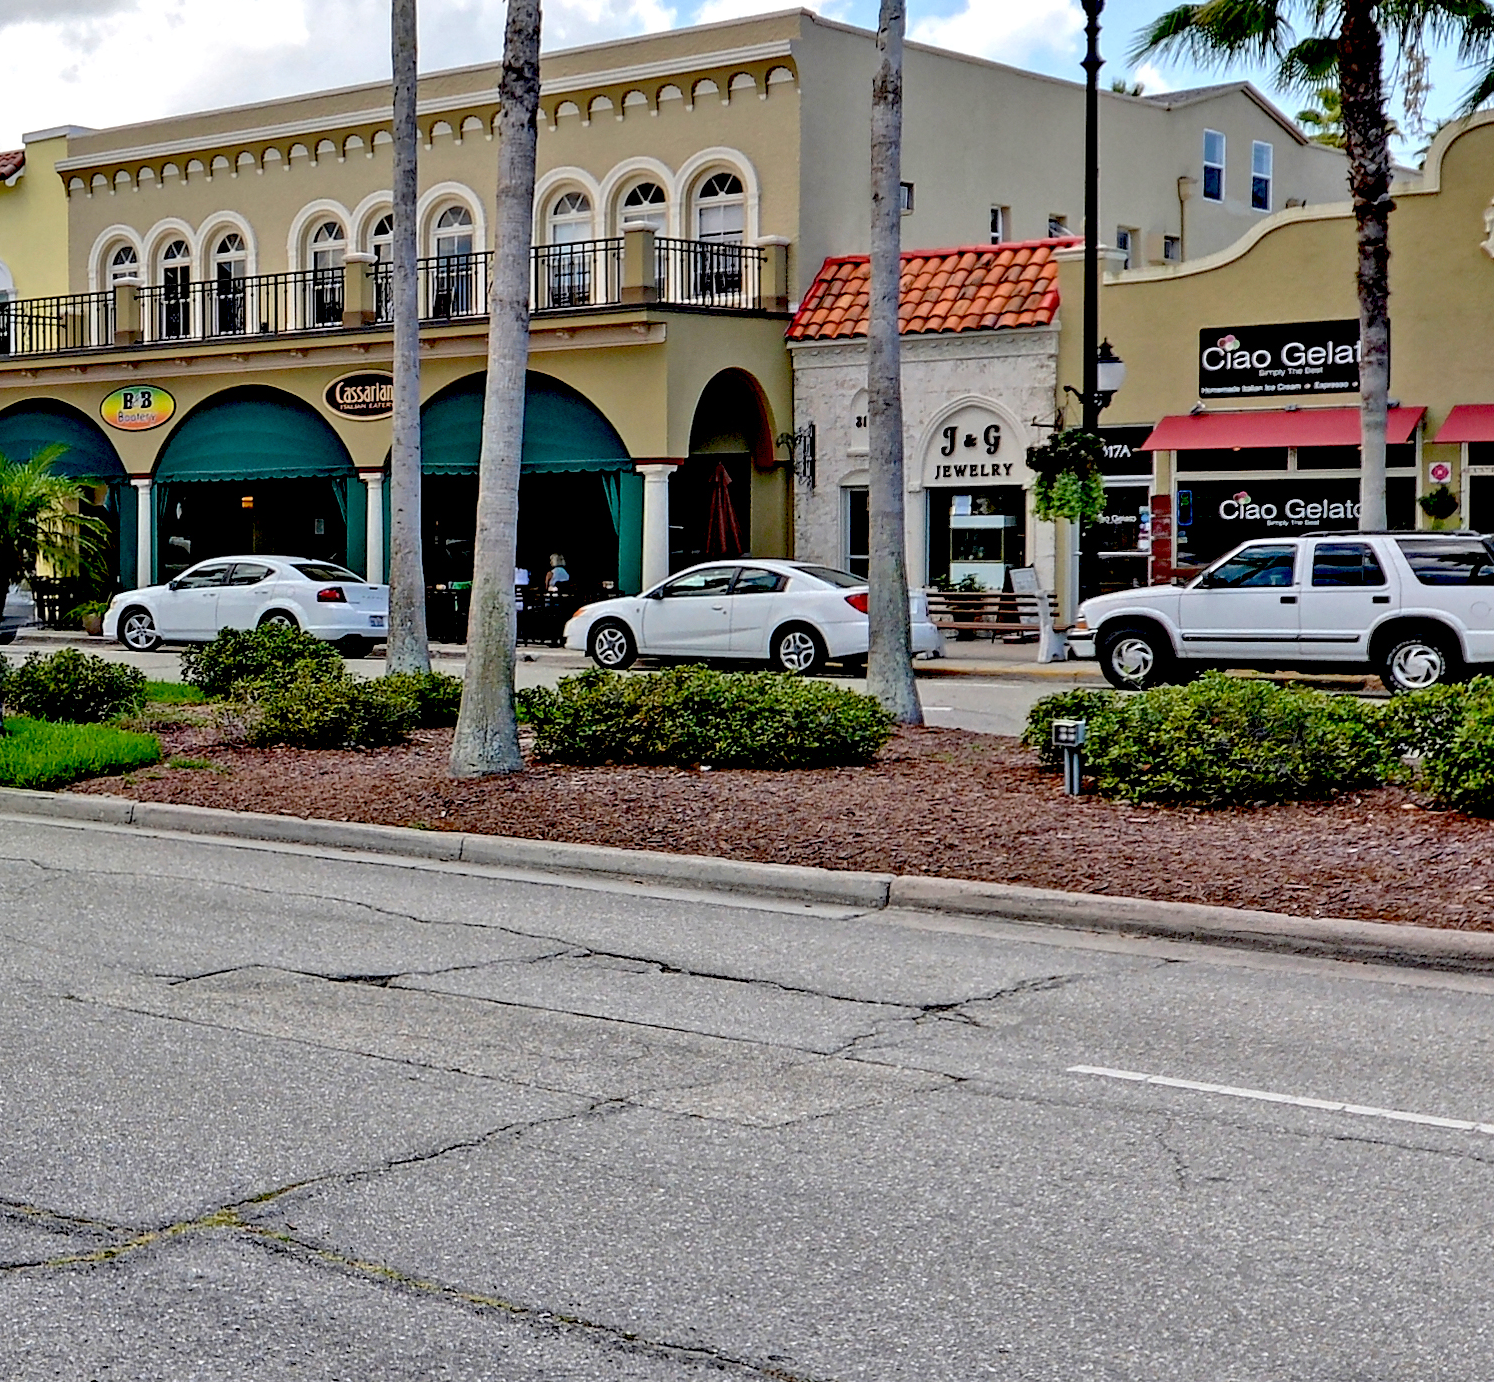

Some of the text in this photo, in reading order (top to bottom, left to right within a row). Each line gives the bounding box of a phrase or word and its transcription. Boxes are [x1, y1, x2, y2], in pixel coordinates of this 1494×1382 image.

[1201, 340, 1362, 372] Ciao Gelat
[335, 382, 393, 404] Cassarian
[940, 424, 1001, 457] J & G
[934, 463, 1014, 479] JEWELRY
[1219, 499, 1278, 520] Ciao
